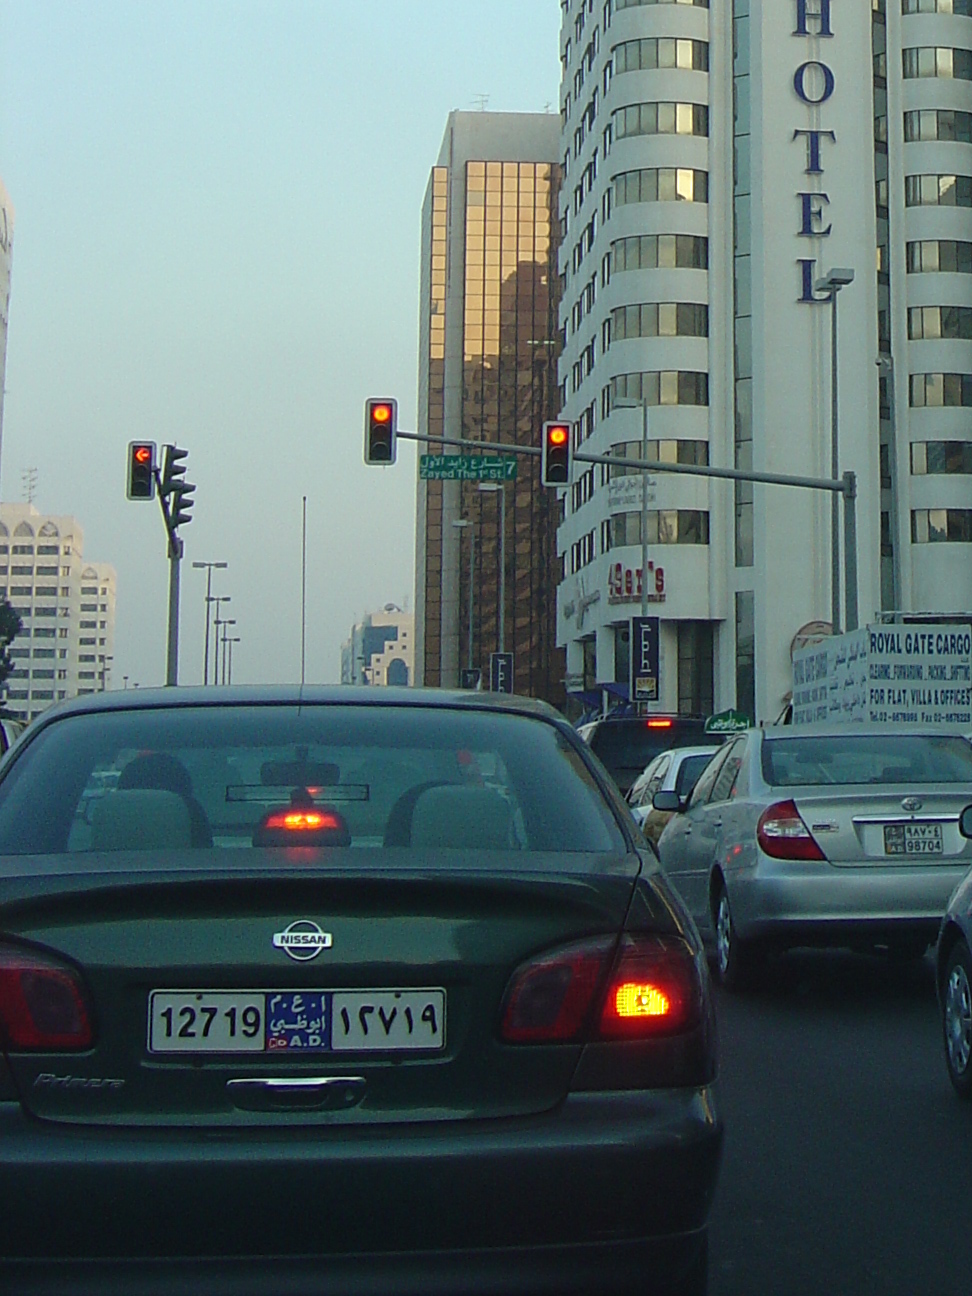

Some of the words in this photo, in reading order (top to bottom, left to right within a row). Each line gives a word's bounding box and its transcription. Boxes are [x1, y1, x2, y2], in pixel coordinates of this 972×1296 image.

[448, 456, 468, 470] زايد
[470, 457, 504, 470] شارع
[506, 461, 516, 475] 7
[420, 469, 455, 479] Zayed
[457, 469, 477, 479] The
[870, 633, 902, 654] ROYAL
[905, 633, 934, 655] GATE
[936, 633, 971, 655] CARGO
[870, 688, 885, 705] FOR
[910, 689, 932, 705] VILLA
[940, 688, 970, 706] OFFICES
[906, 826, 940, 838] ٩٨٧٠٤
[907, 840, 941, 852] 98704
[280, 935, 328, 945] NISSAN
[160, 1006, 261, 1038] 12719
[340, 1003, 438, 1036] ١٢٧١٩
[289, 1035, 325, 1047] A.D.
